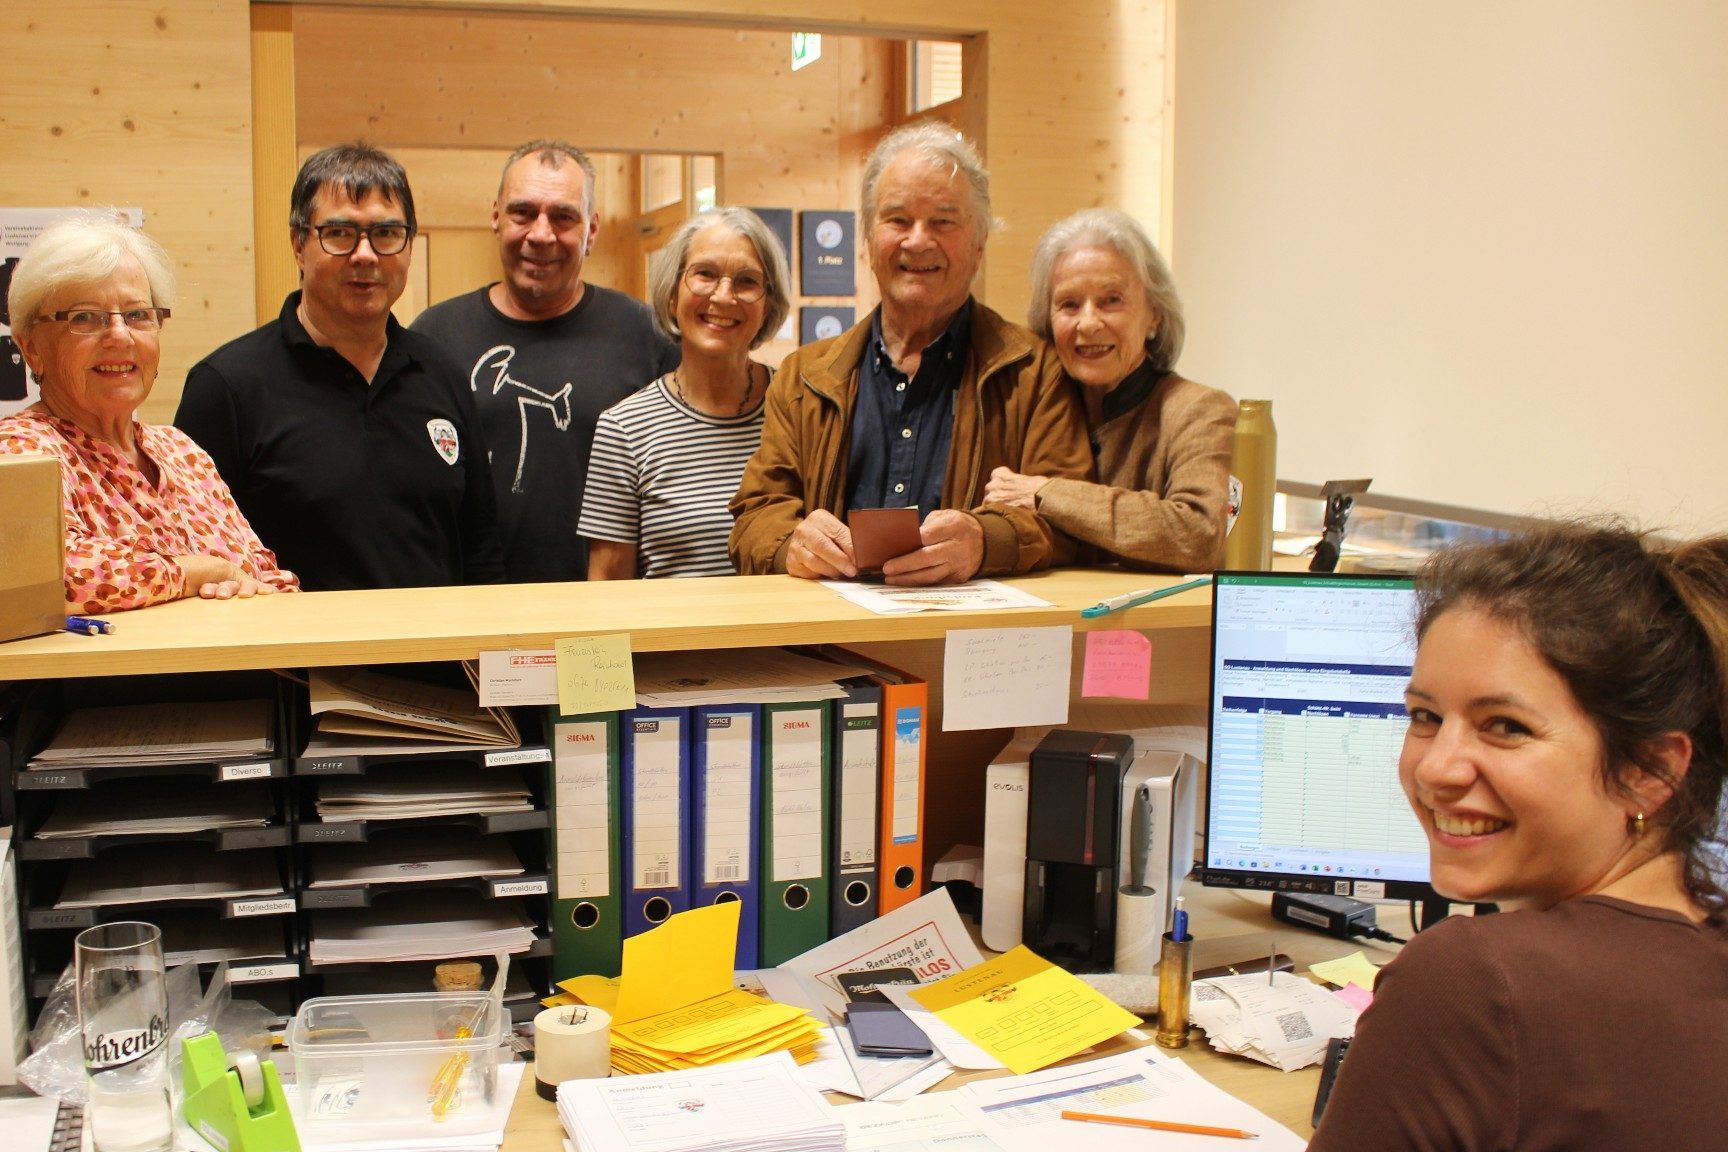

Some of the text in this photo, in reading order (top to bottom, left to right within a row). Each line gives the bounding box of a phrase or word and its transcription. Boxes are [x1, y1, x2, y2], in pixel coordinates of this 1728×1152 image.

[783, 720, 810, 730] SIGMA
[852, 719, 873, 727] LEITZ
[566, 733, 595, 743] SIGMA
[992, 781, 1024, 792] evolis
[500, 883, 543, 895] Anmeldung
[238, 900, 292, 915] Mitgliedsbeitr.
[866, 946, 914, 969] Benutzung
[914, 938, 928, 950] der
[922, 948, 935, 960] ist
